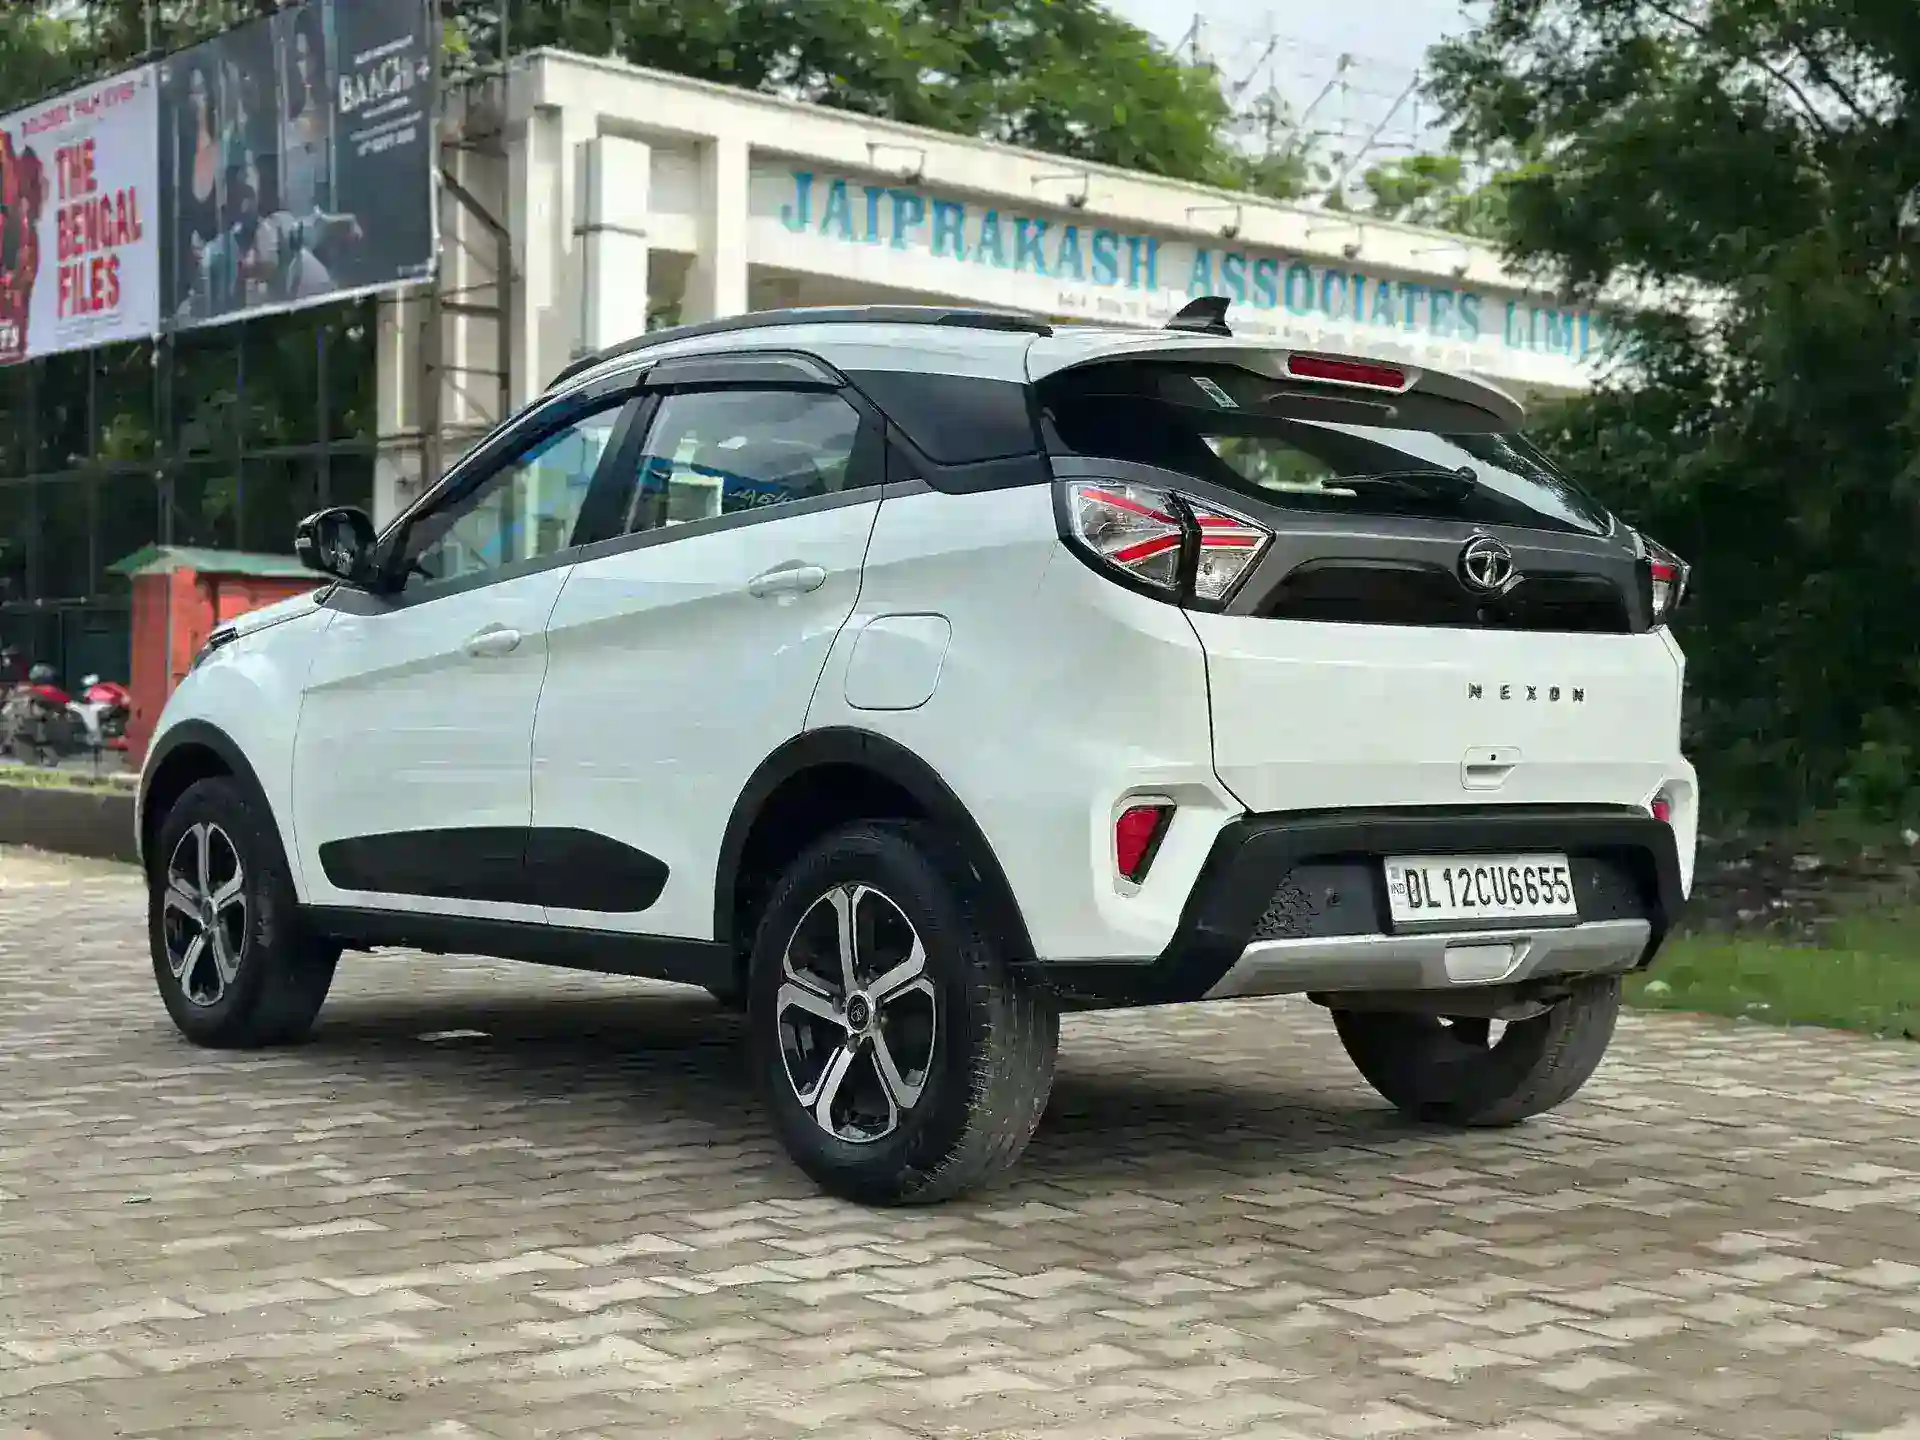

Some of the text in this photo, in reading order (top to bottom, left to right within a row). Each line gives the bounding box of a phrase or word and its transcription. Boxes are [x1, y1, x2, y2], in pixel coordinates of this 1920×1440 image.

[56, 137, 97, 200] THE
[57, 185, 142, 260] BENGAL
[57, 254, 120, 318] FILES
[782, 172, 1616, 363] JAIPRAKASH ASSOCIATES LIMI
[1467, 683, 1585, 703] NEXON
[1405, 865, 1572, 909] DL12CU6655
